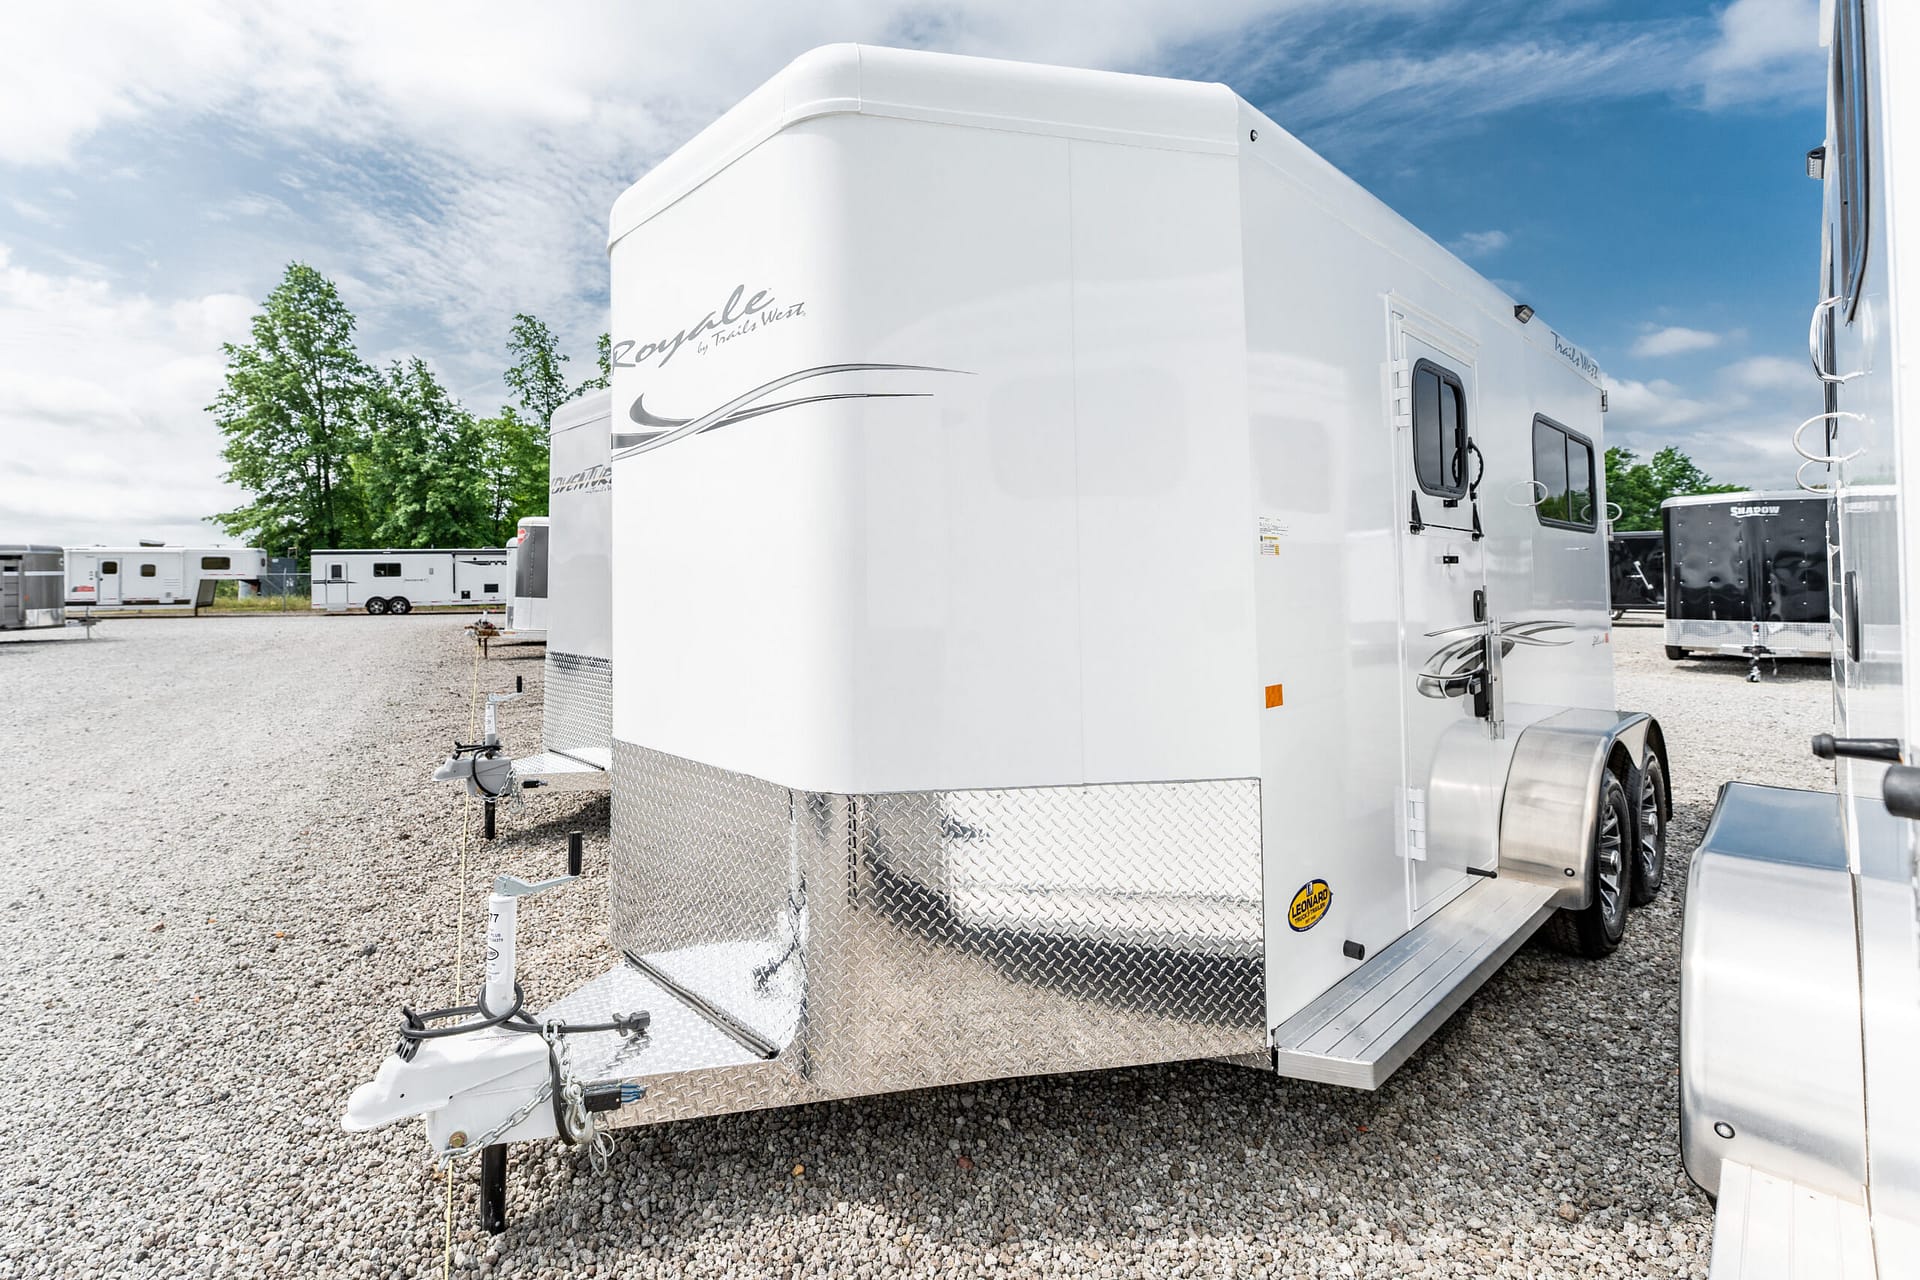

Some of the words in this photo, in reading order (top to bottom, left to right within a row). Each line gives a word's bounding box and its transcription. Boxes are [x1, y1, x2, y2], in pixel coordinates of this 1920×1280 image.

[612, 284, 775, 375] Royale
[697, 342, 709, 356] by
[712, 320, 757, 346] Trails
[761, 302, 805, 326] West
[1730, 506, 1780, 517] SHADOW
[1292, 888, 1328, 918] LEONARD
